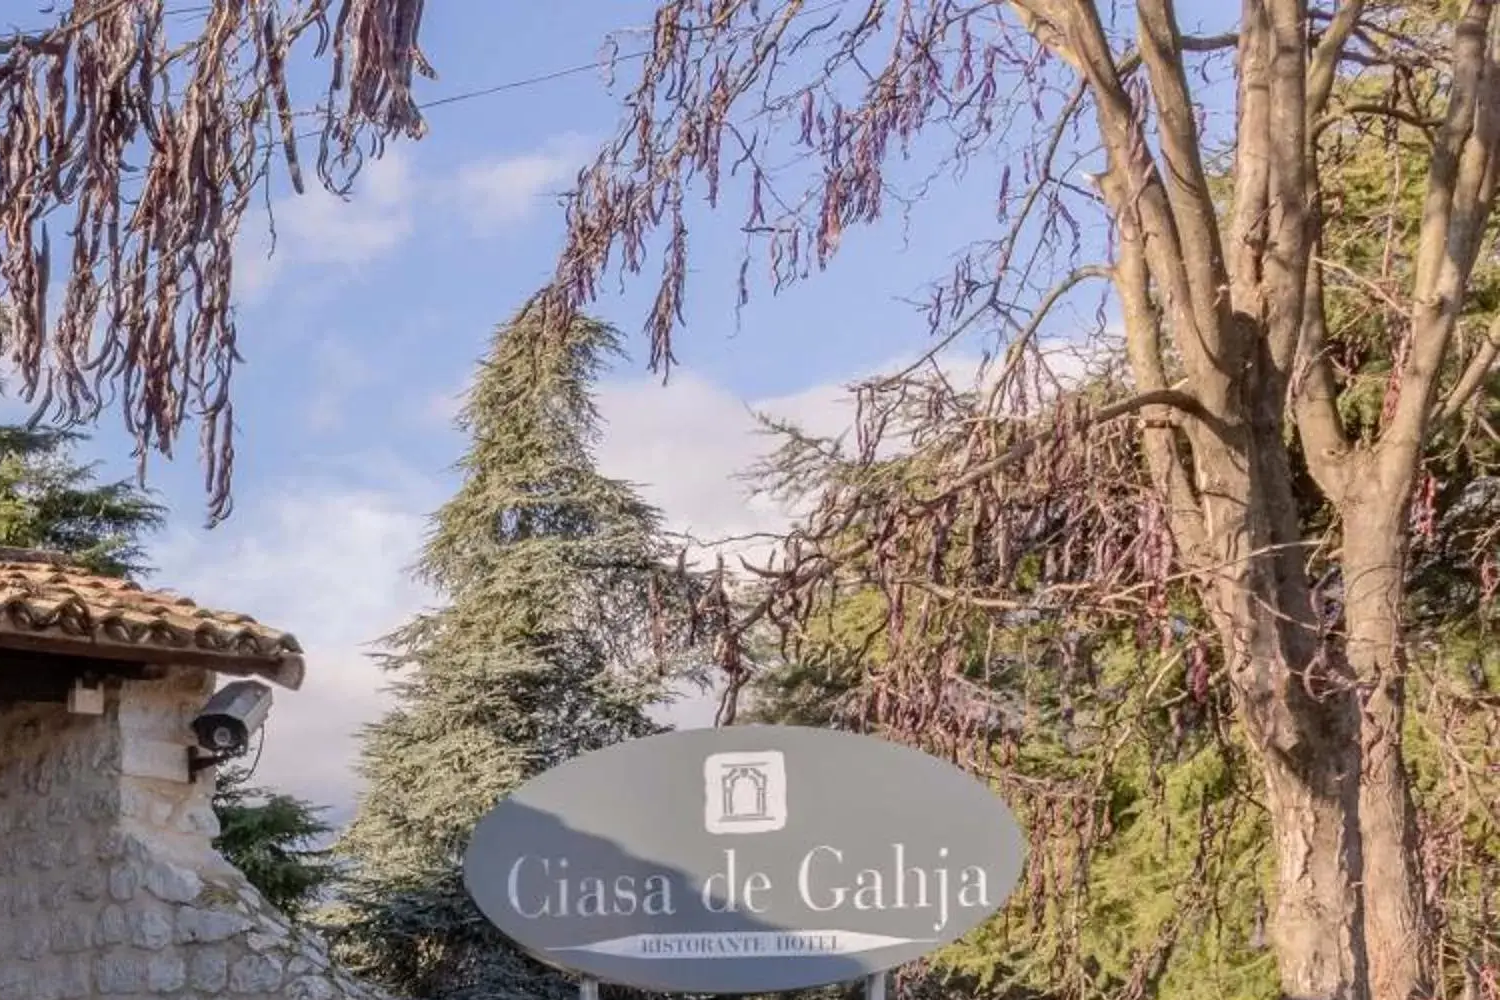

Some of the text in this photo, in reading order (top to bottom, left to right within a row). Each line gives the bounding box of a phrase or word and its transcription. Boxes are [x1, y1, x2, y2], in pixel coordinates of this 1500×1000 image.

[507, 843, 992, 932] Ciasa de Gahja
[641, 934, 841, 954] RISTORANTE HOTEL
